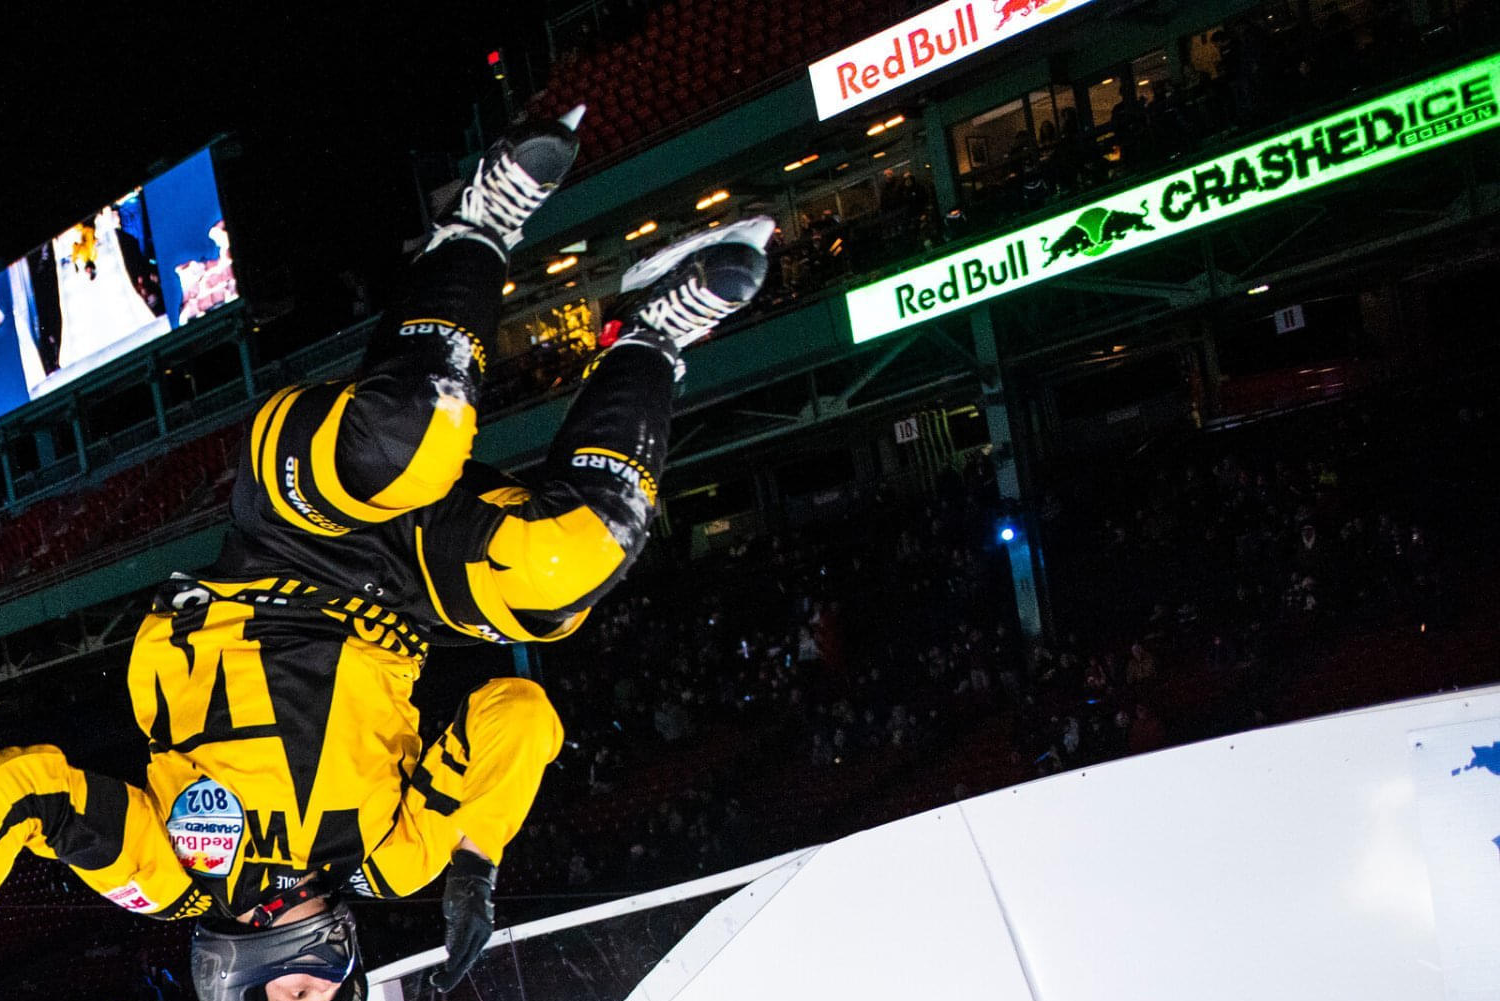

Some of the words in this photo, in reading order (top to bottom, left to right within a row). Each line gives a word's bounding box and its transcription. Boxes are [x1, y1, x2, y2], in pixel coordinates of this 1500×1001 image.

[837, 38, 905, 100] Red
[908, 3, 979, 68] Bull
[1404, 105, 1494, 146] BOSTON
[894, 266, 958, 319] Red
[964, 240, 1030, 296] Bull
[1159, 106, 1405, 224] CRASHED
[1405, 74, 1493, 129] ICE
[187, 787, 228, 813] 802
[185, 822, 241, 834] CRASHED
[201, 836, 234, 853] Red
